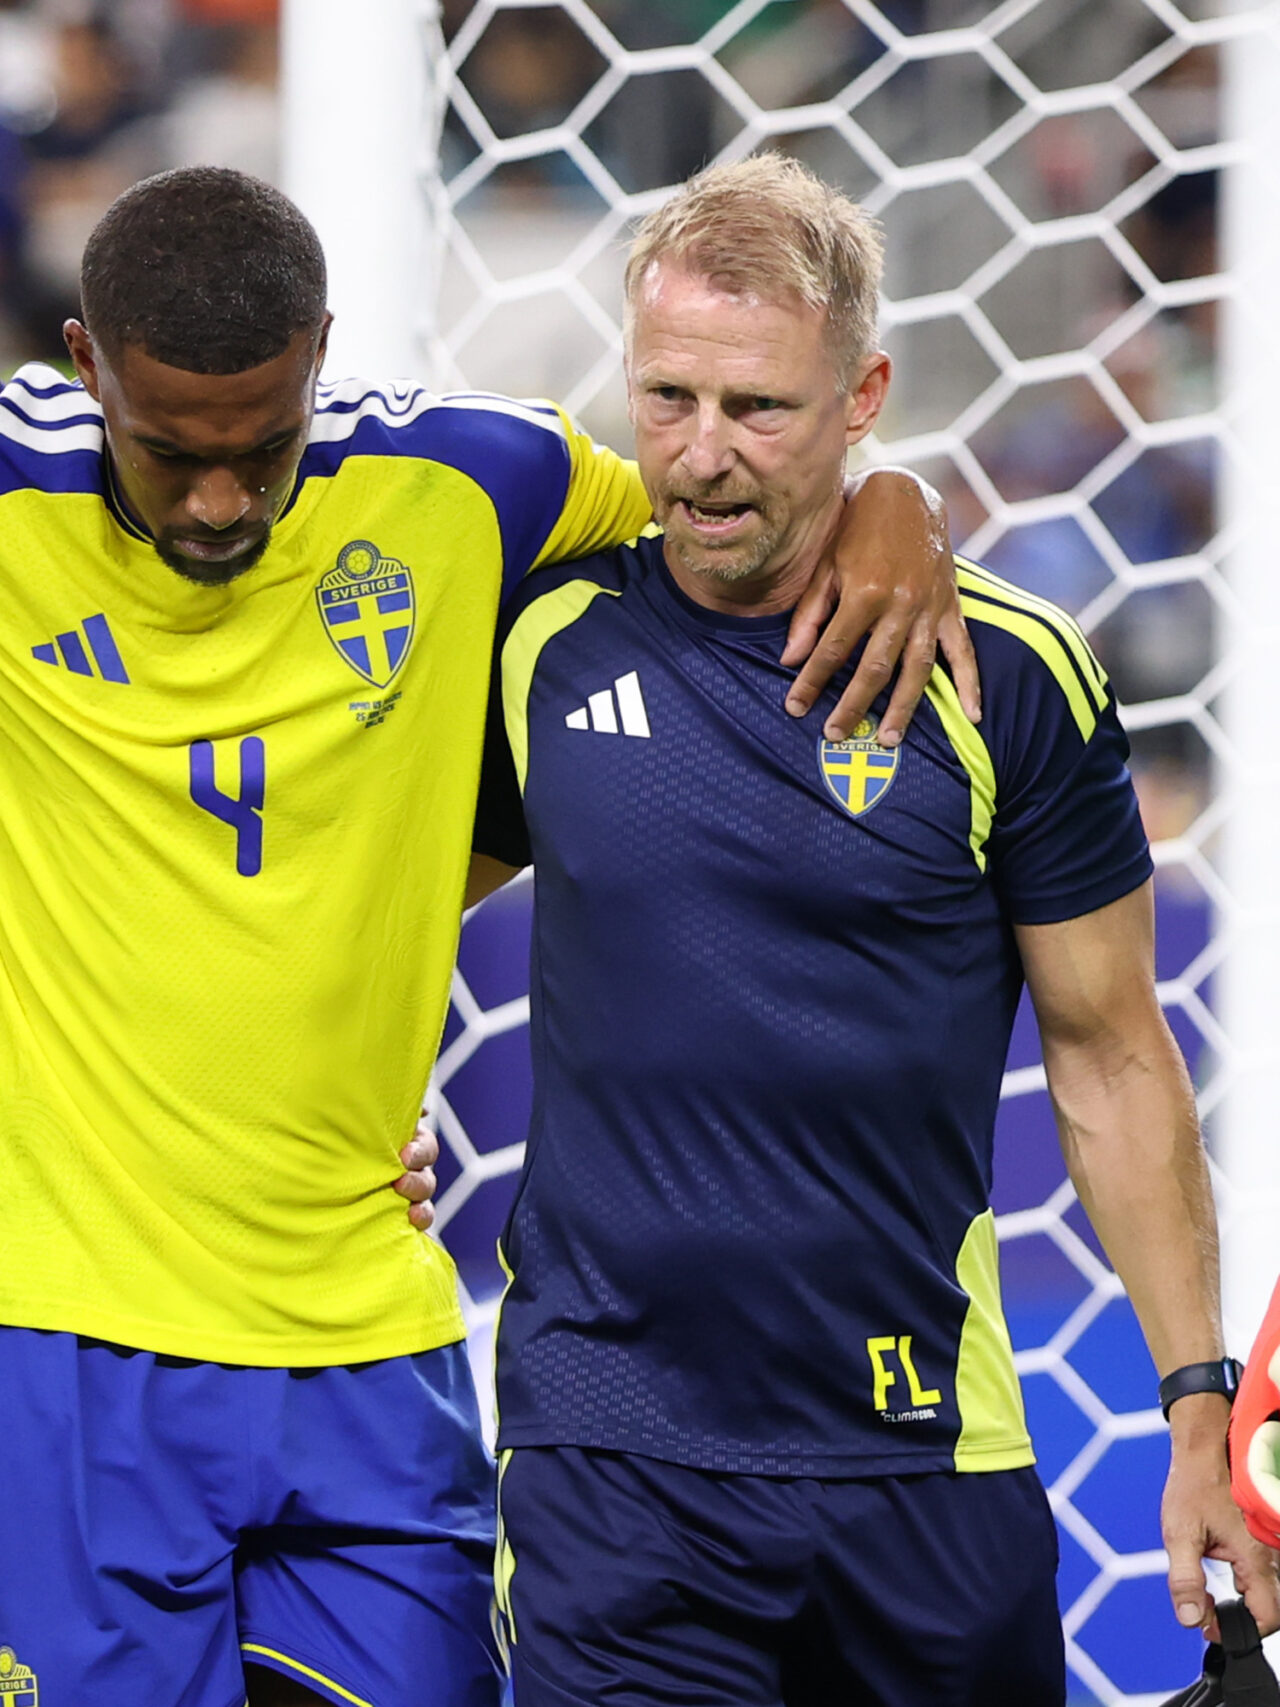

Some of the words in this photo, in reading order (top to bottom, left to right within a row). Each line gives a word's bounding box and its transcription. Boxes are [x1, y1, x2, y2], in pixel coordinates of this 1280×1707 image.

[331, 577, 397, 601] SVERIGE
[189, 735, 265, 878] 4
[867, 1335, 942, 1411] FL
